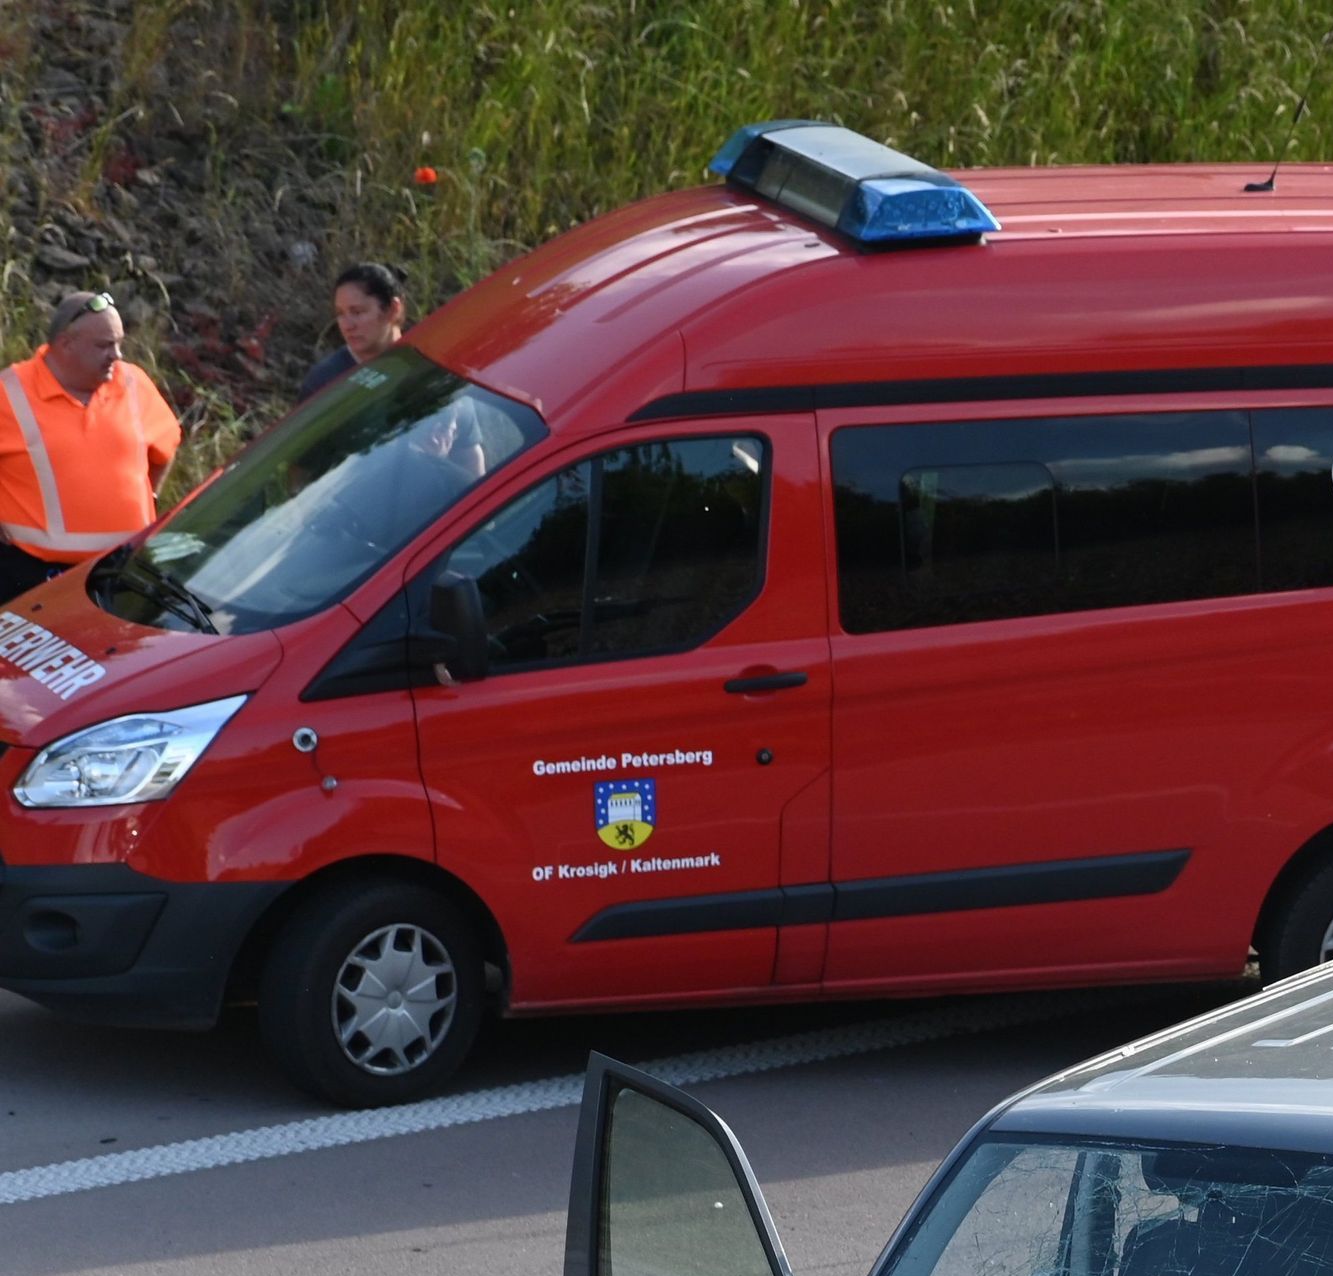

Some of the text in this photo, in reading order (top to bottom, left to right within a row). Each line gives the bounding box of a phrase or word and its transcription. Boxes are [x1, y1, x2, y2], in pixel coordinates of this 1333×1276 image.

[533, 749, 713, 776] Gemeinde Petersberg
[532, 866, 554, 881] OF
[558, 861, 618, 879] Krosigk
[630, 852, 721, 873] Kaltenmark
